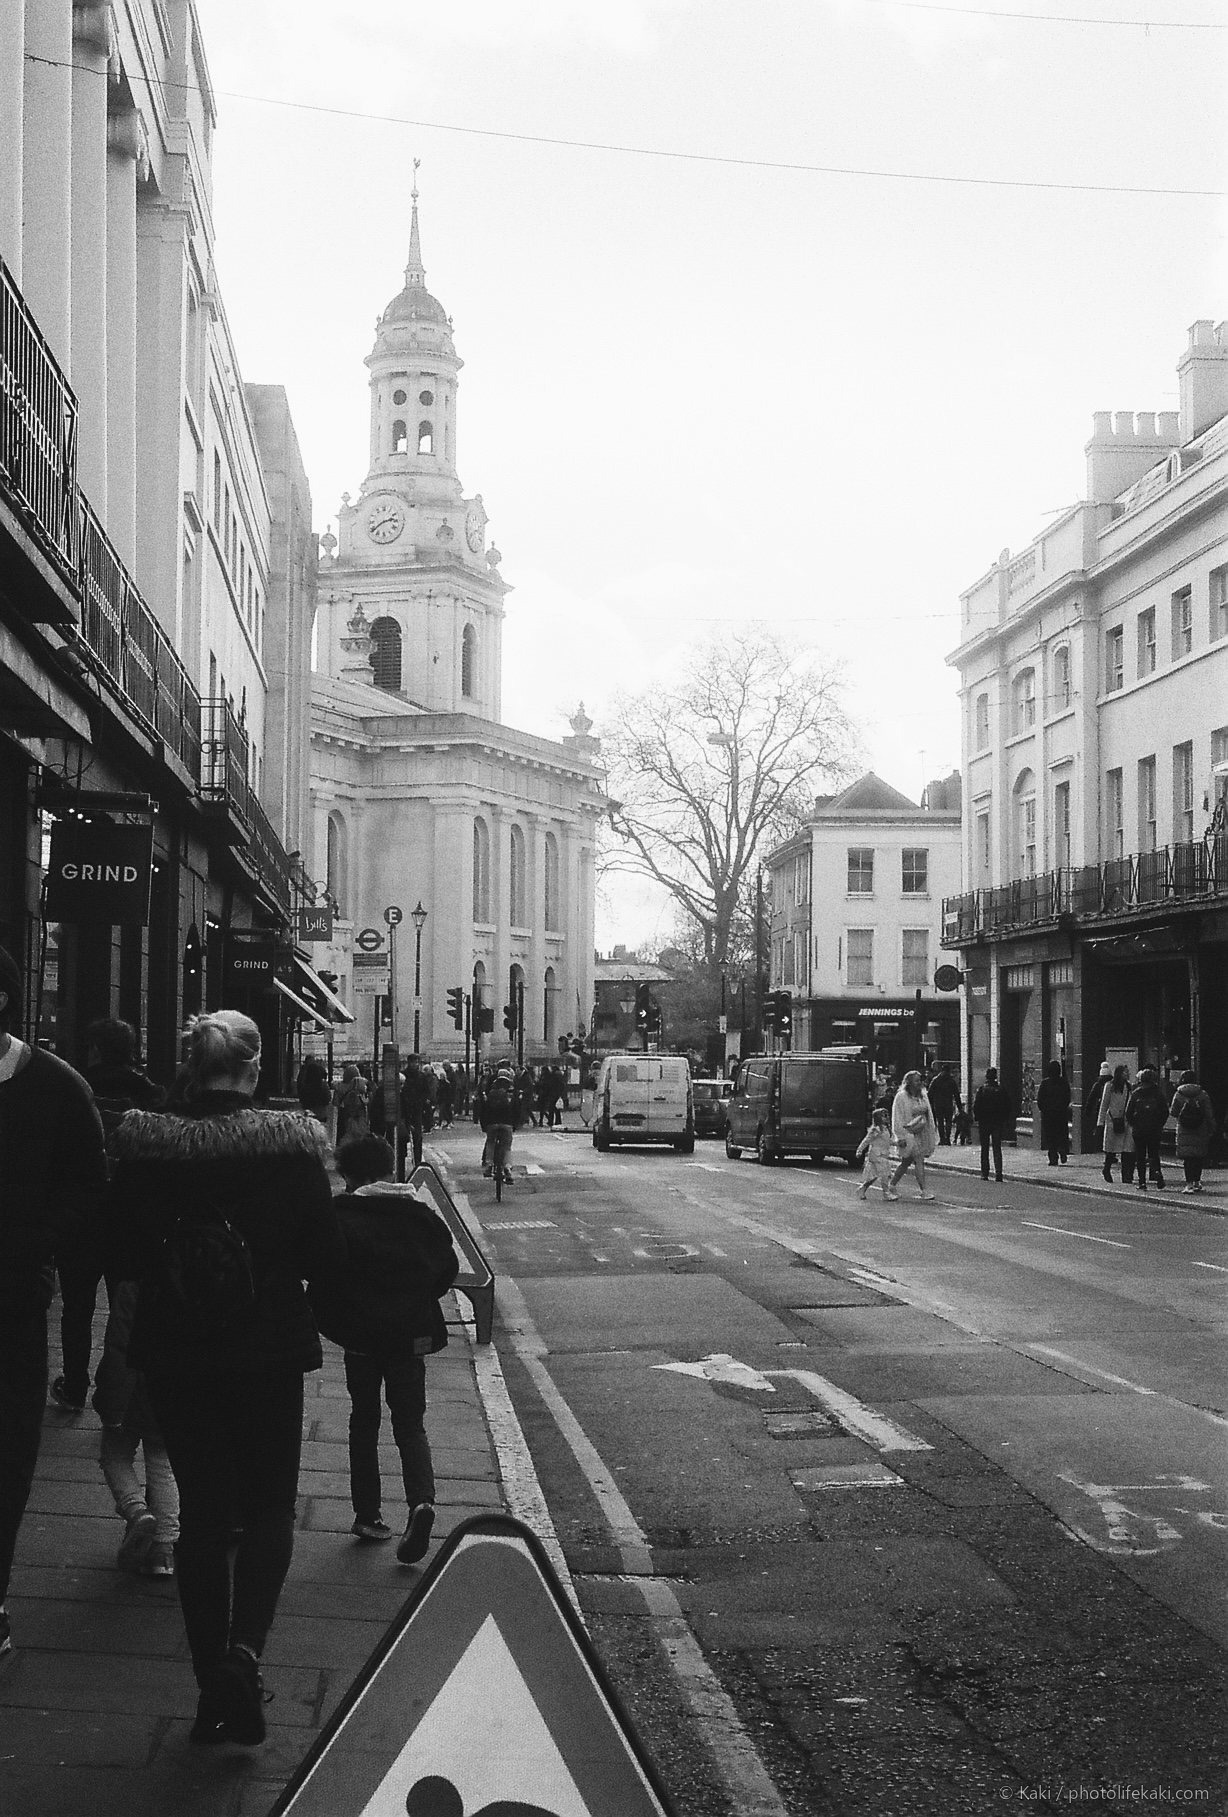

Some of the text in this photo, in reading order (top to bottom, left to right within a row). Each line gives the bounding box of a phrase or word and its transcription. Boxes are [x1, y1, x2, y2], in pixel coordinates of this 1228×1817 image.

[61, 863, 138, 882] GRIND
[389, 909, 398, 923] E
[233, 960, 269, 970] GRIND
